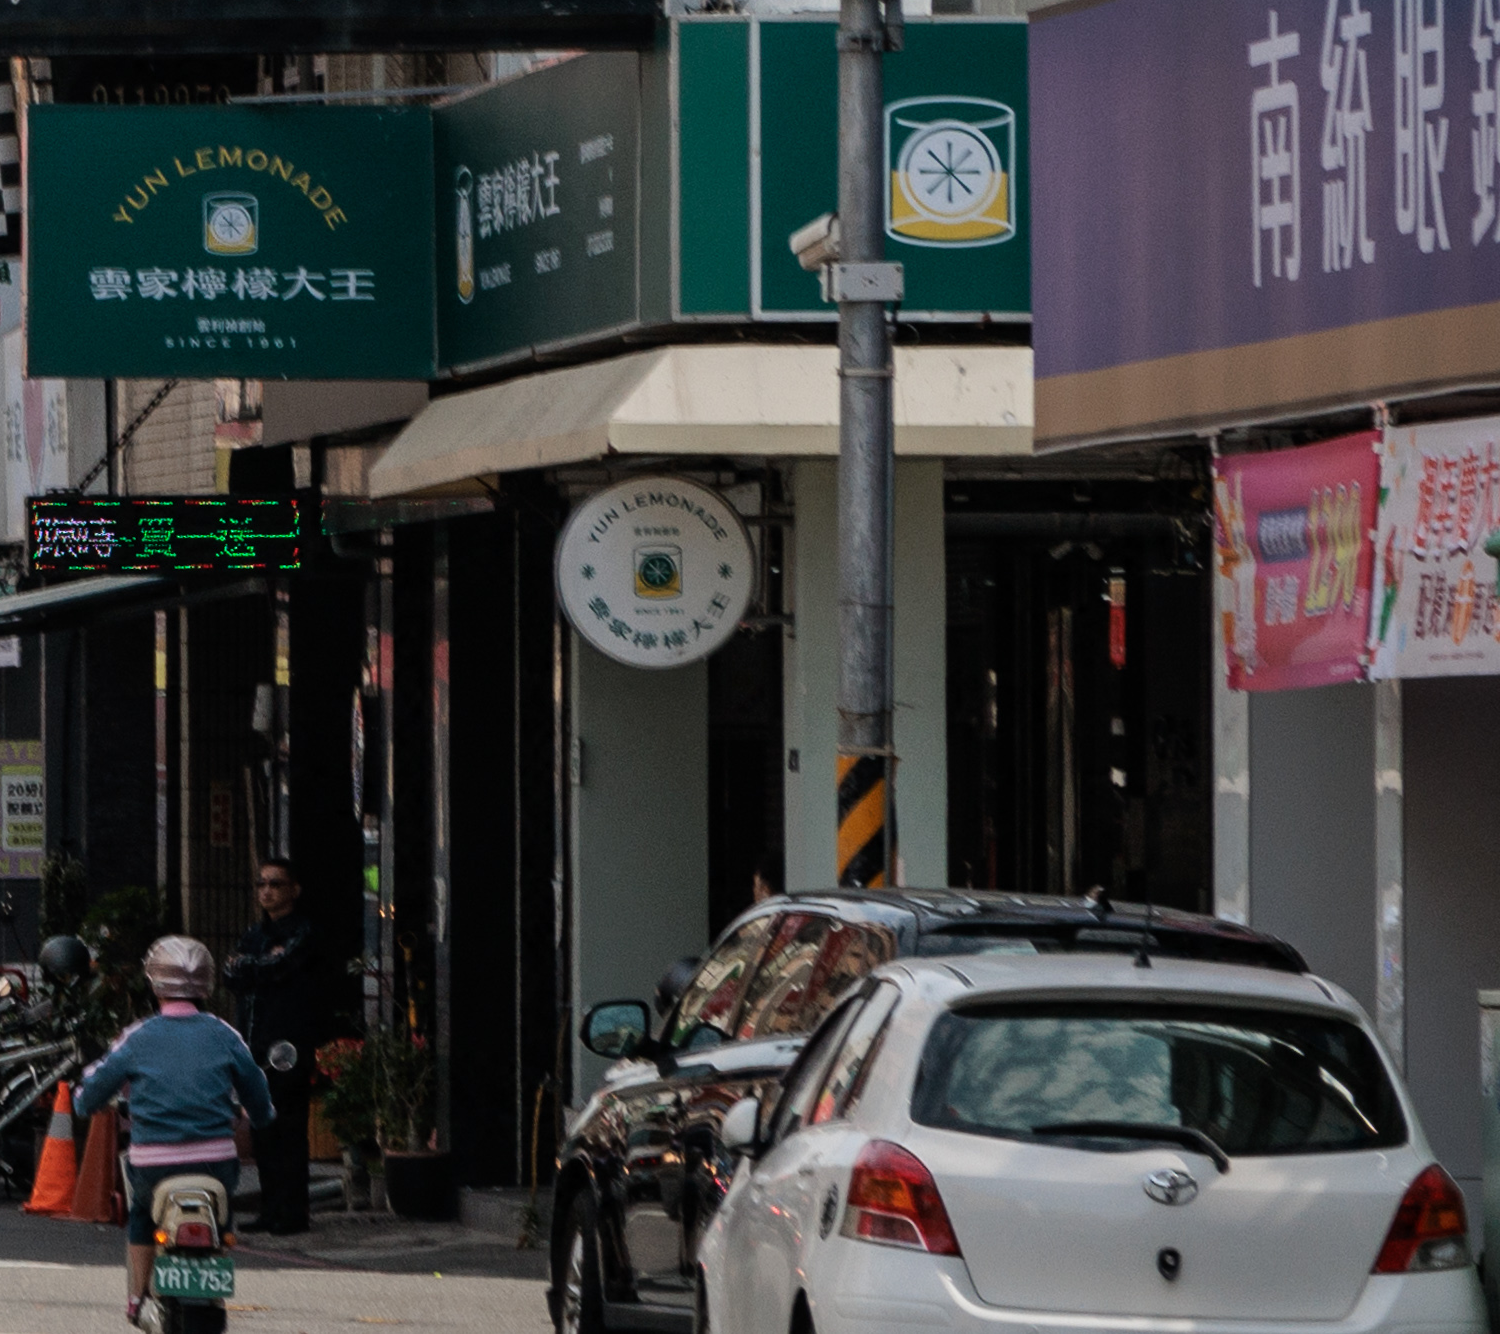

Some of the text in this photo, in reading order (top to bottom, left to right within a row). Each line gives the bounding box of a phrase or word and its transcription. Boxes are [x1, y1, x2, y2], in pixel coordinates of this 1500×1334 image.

[111, 144, 349, 232] YUN LEMONADE
[88, 265, 376, 302] 雲家檸檬大王
[588, 492, 729, 543] YUN LEMONADE
[155, 1265, 233, 1293] YRT-752
